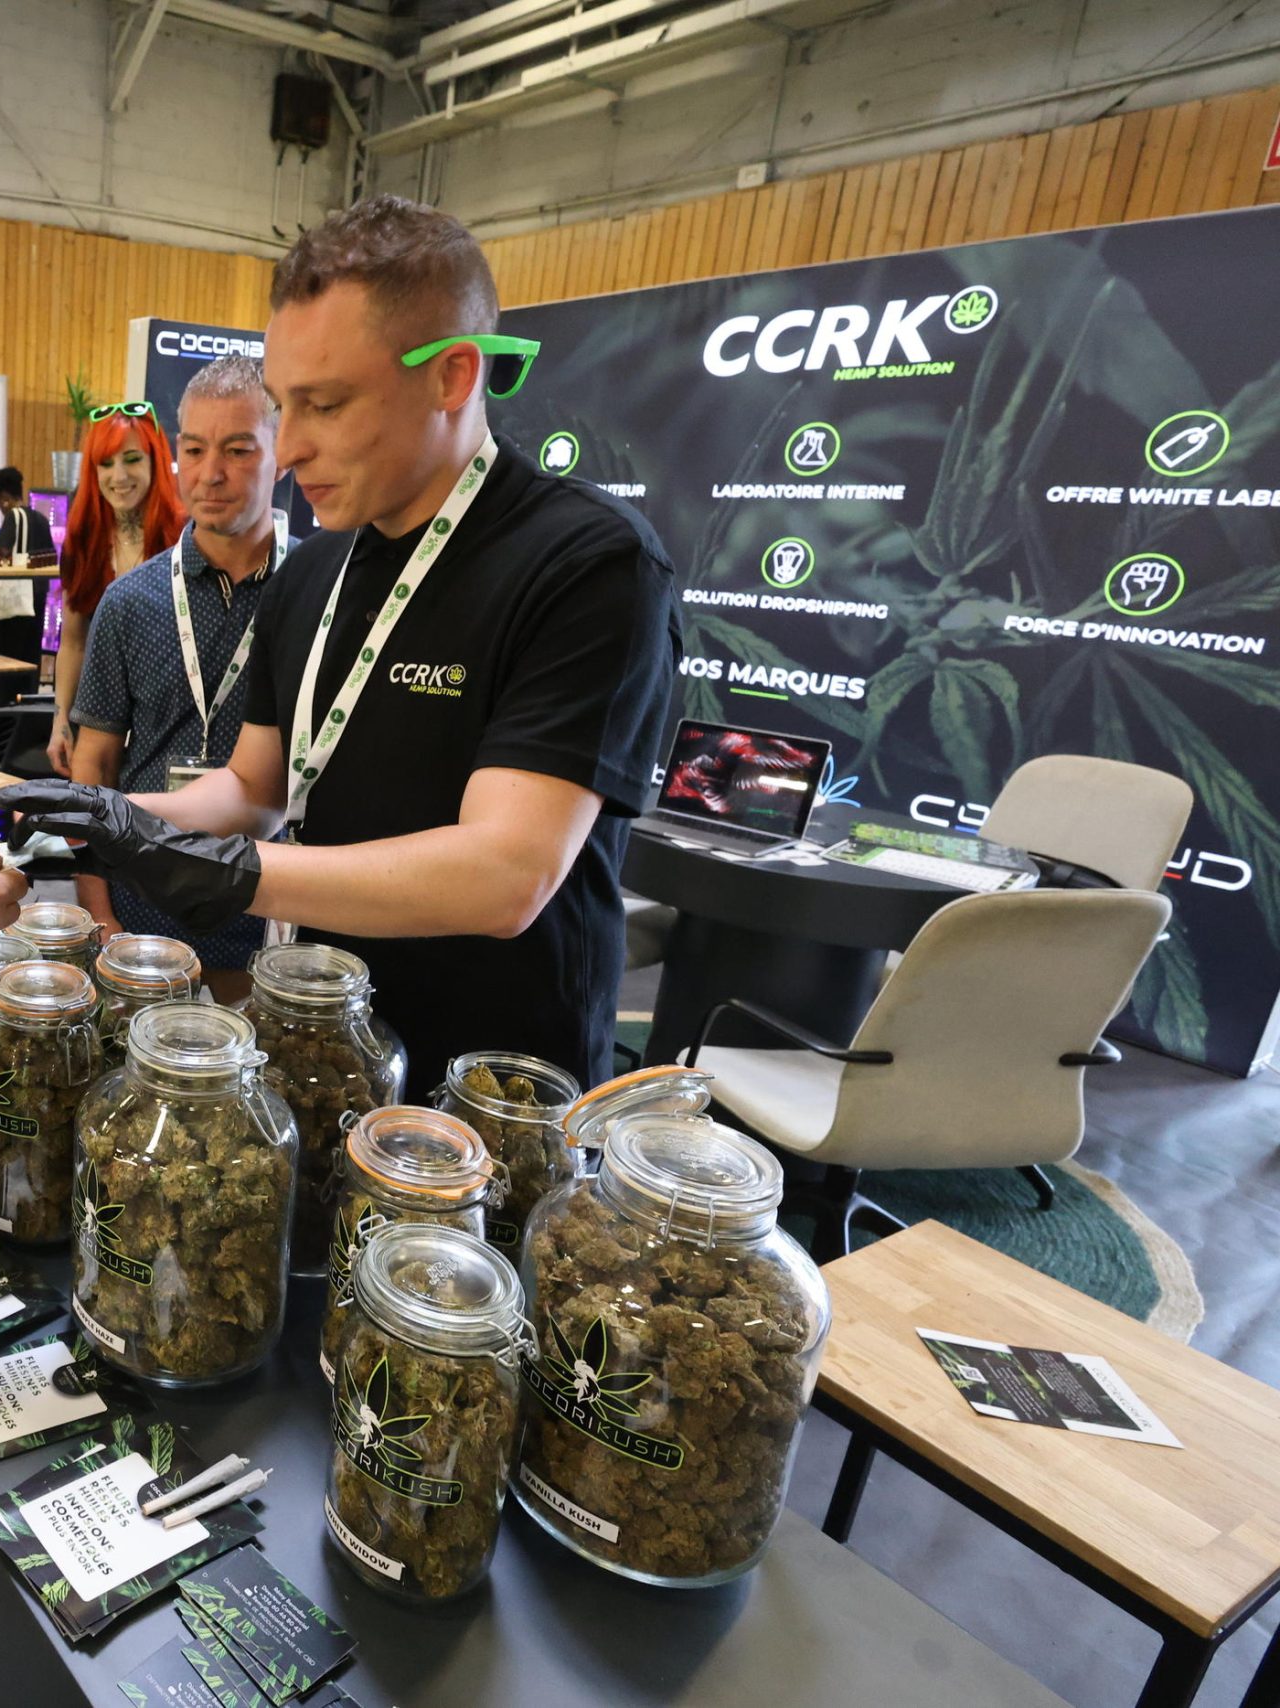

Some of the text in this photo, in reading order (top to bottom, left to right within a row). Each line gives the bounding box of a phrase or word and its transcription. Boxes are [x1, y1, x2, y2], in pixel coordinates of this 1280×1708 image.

[702, 294, 951, 377] CCRK
[833, 361, 955, 381] HEMP SOLUTION
[595, 484, 647, 497] UTEUR
[712, 484, 905, 500] LABORATOIRE INTERNE
[1046, 486, 1124, 503] OFFRE
[1128, 487, 1213, 505] WHITE
[682, 589, 888, 619] SOLUTION DROPSHIPPING
[1004, 615, 1265, 655] FORCE D'INNOVATION
[389, 662, 449, 687] CCRK
[679, 656, 866, 700] NOS MARQUES
[426, 686, 462, 697] SOLUTION
[95, 1327, 114, 1345] HAZE
[2, 1362, 25, 1390] HUILES
[25, 1356, 49, 1387] FLEURS
[521, 1358, 671, 1463] COCORIKUSH
[77, 1486, 111, 1522] HUILES
[100, 1474, 137, 1515] FLEURS
[525, 1471, 601, 1532] VANILLA KUSH
[39, 1504, 52, 1514] ET
[47, 1515, 69, 1536] PLUS
[49, 1498, 115, 1574] COSMÉTIQUES
[63, 1493, 115, 1552] INFUSIONS
[326, 1508, 390, 1571] WHITE WIDOW
